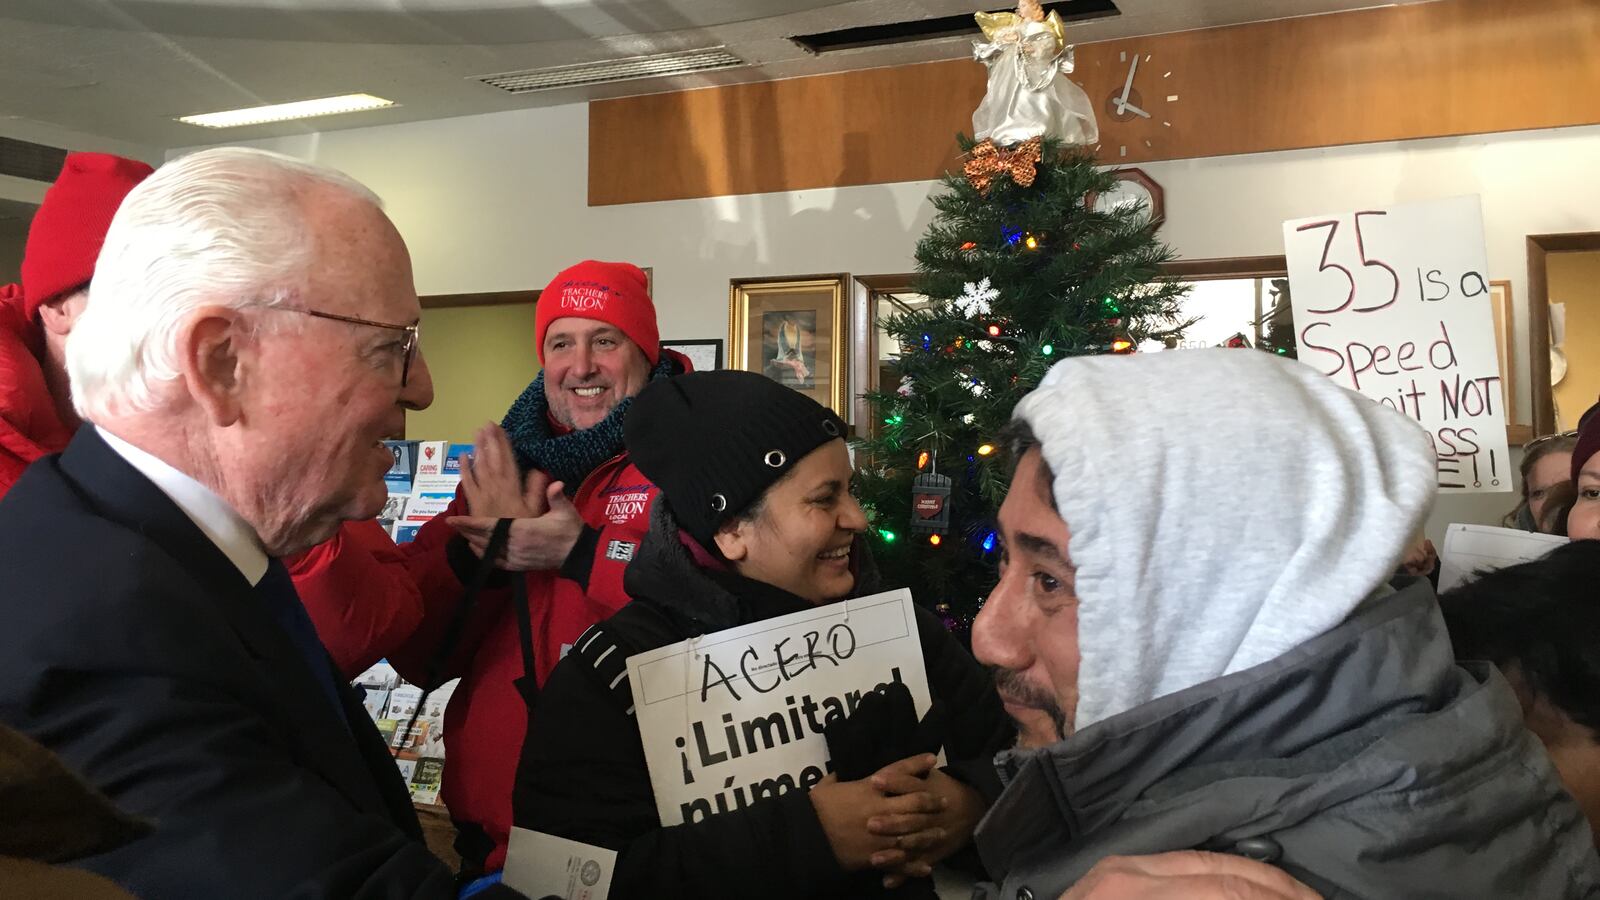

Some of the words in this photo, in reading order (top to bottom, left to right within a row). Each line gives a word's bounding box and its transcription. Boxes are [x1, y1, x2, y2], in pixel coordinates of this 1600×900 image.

[1296, 210, 1399, 314] 35
[1460, 271, 1488, 297] a
[561, 295, 604, 310] UNION
[562, 288, 609, 300] TEACHERS
[1301, 320, 1458, 391] Speed
[1440, 374, 1500, 421] NOT
[605, 502, 646, 515] UNION
[608, 493, 648, 503] TEACHERS
[701, 623, 856, 703] ACERO
